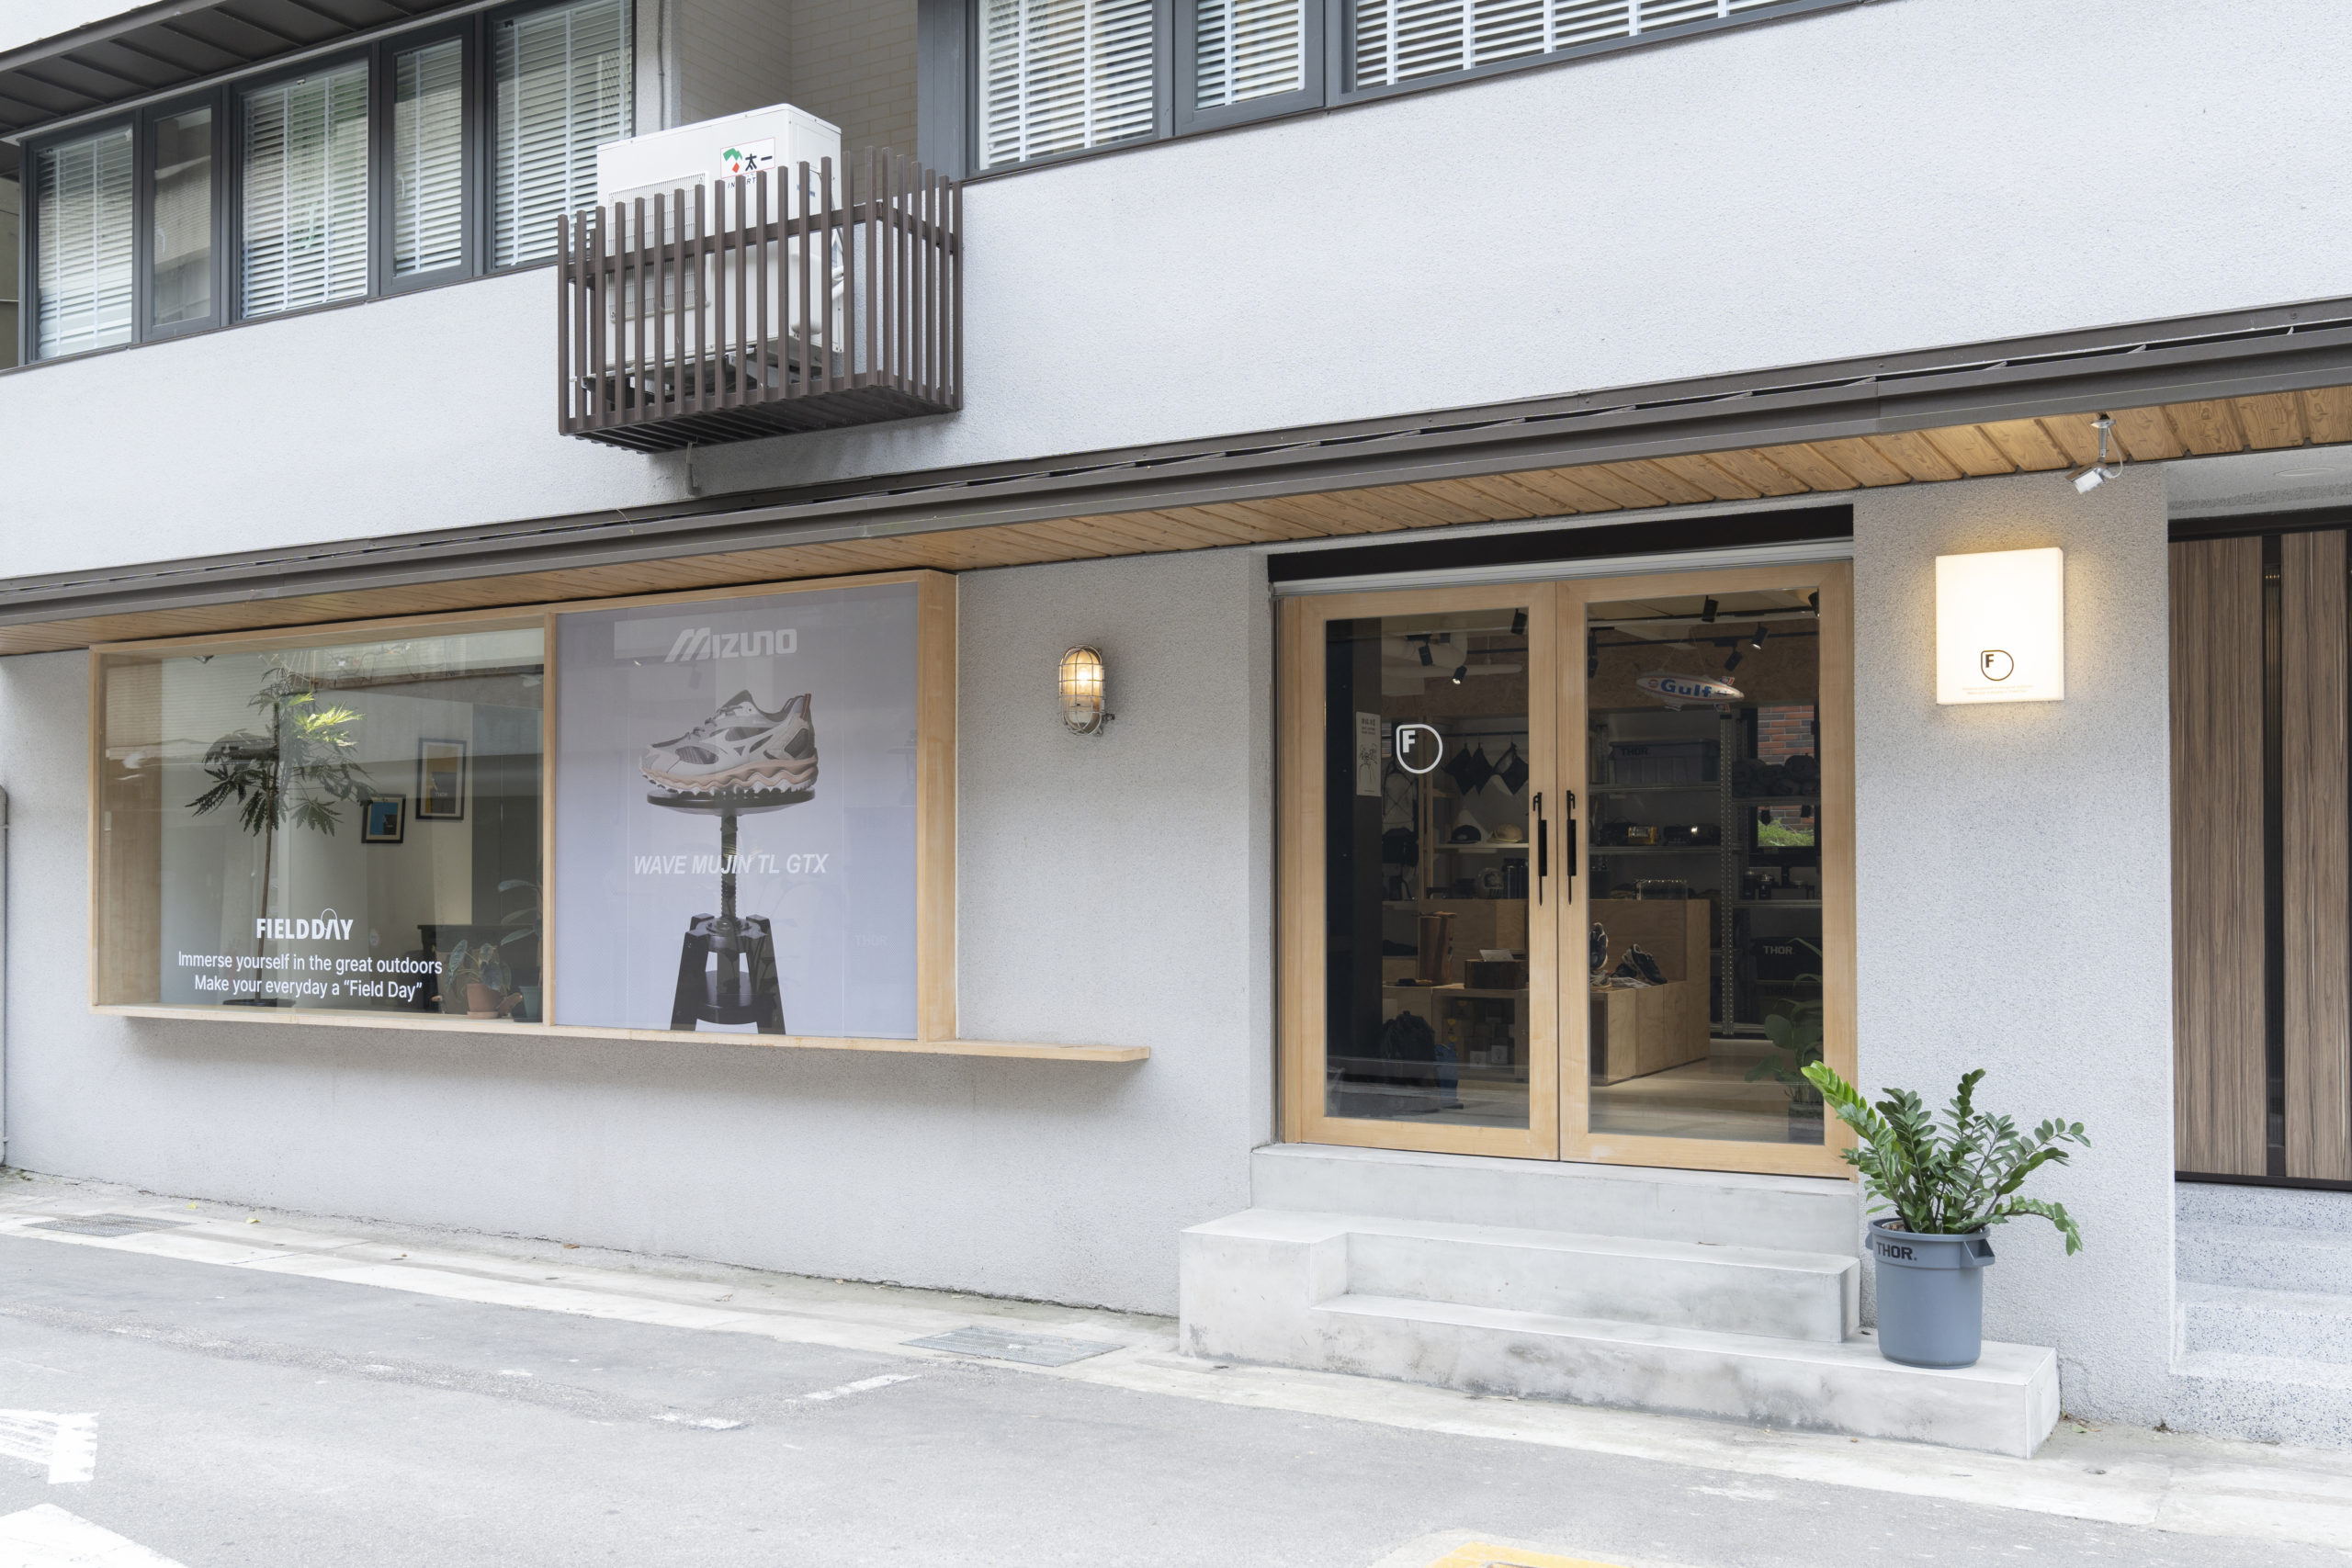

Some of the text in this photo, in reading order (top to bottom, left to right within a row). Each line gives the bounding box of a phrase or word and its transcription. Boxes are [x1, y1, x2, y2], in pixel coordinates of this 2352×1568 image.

[745, 153, 773, 172] 太一
[664, 626, 797, 663] MIZUNO
[1985, 653, 1995, 669] F
[1660, 679, 1713, 698] Gulf
[1402, 729, 1416, 753] F
[634, 853, 830, 875] WAVE MUJIN TL GTX
[1762, 945, 1793, 955] THOR
[178, 951, 443, 976] Immerse yourself in the great outdoors
[195, 975, 230, 991] Make
[232, 979, 263, 996] your
[266, 979, 328, 998] everyday
[332, 983, 340, 996] a
